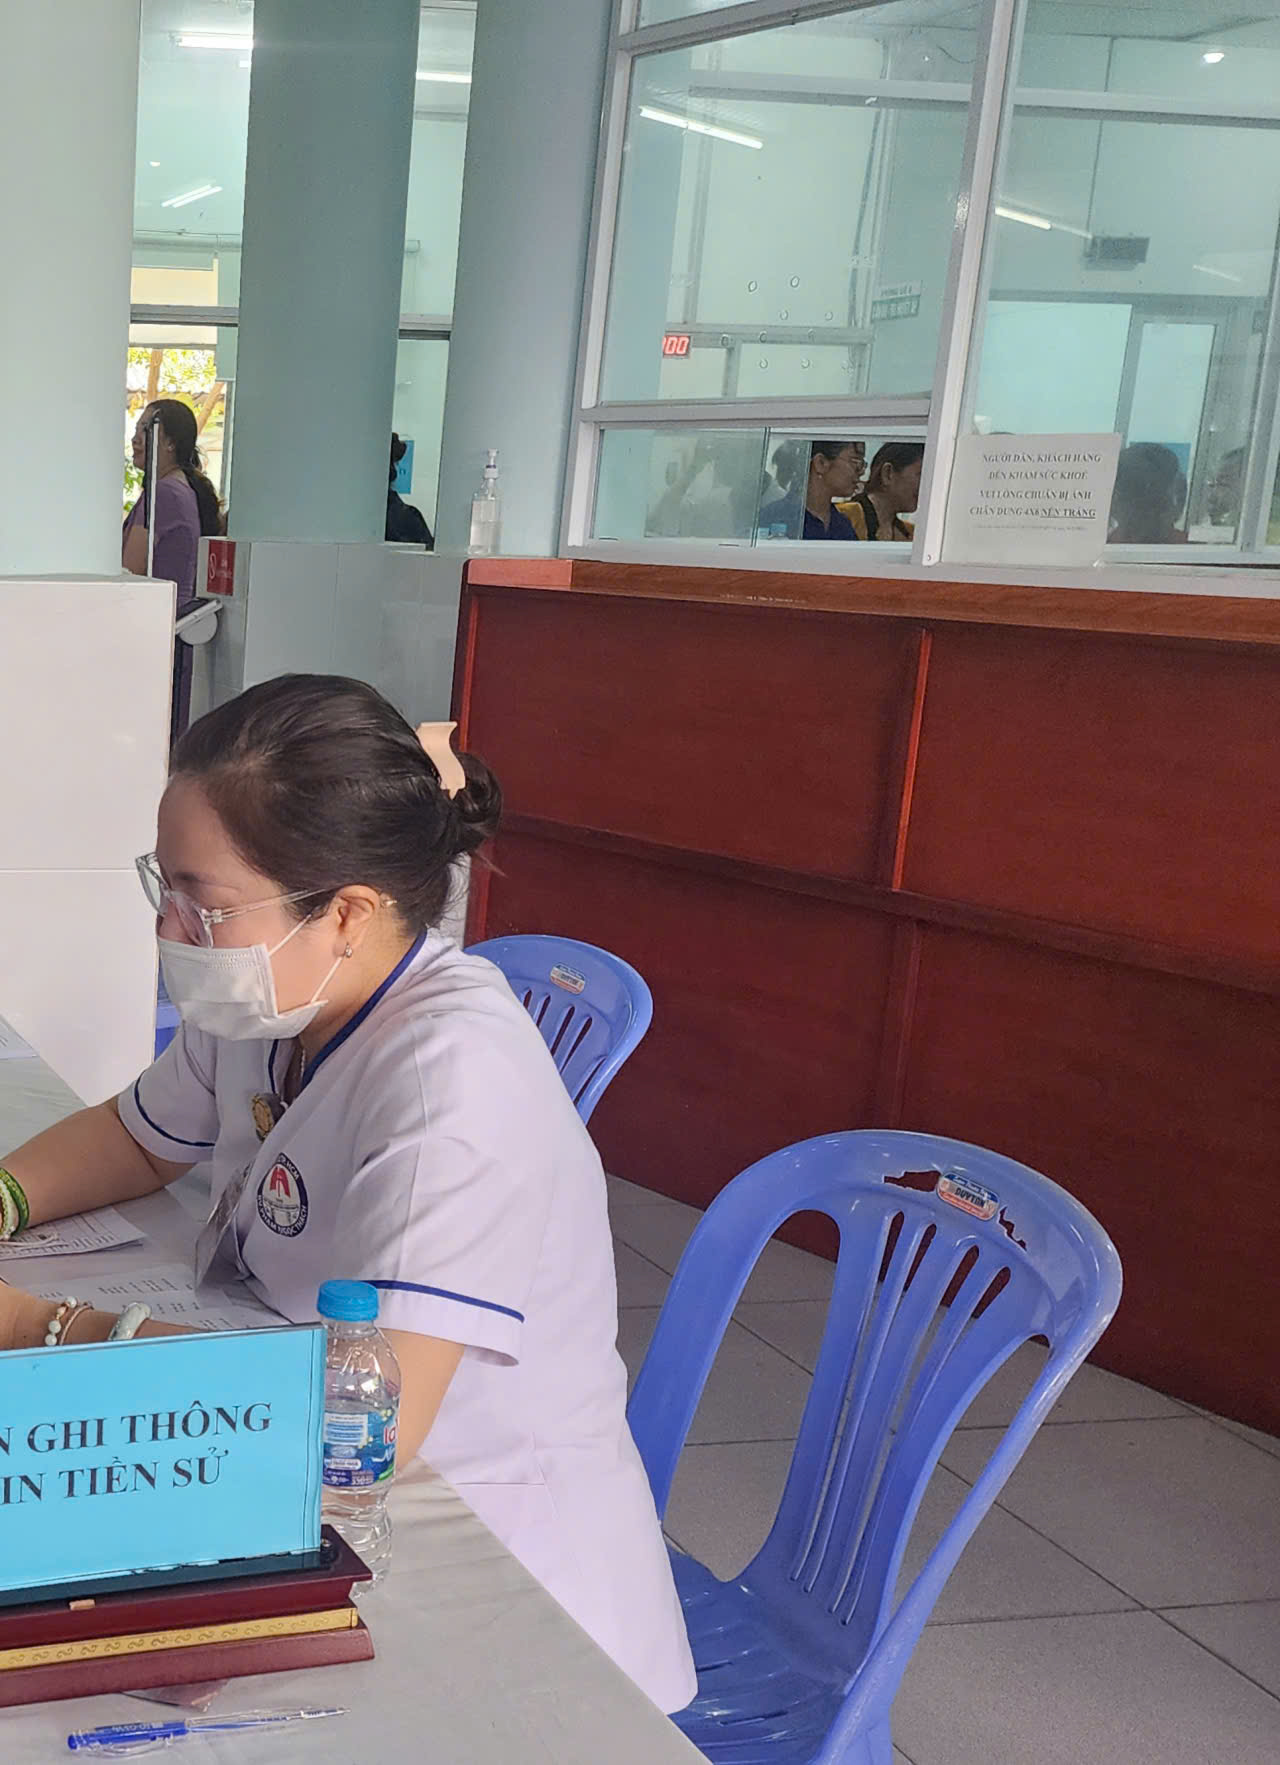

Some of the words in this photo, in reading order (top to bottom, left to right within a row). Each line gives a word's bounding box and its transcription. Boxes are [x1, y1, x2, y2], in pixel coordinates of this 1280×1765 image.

[27, 1417, 107, 1453] GHI
[120, 1400, 273, 1445] THÔNG
[58, 1456, 159, 1499] TIỀN
[172, 1446, 229, 1488] SỬ
